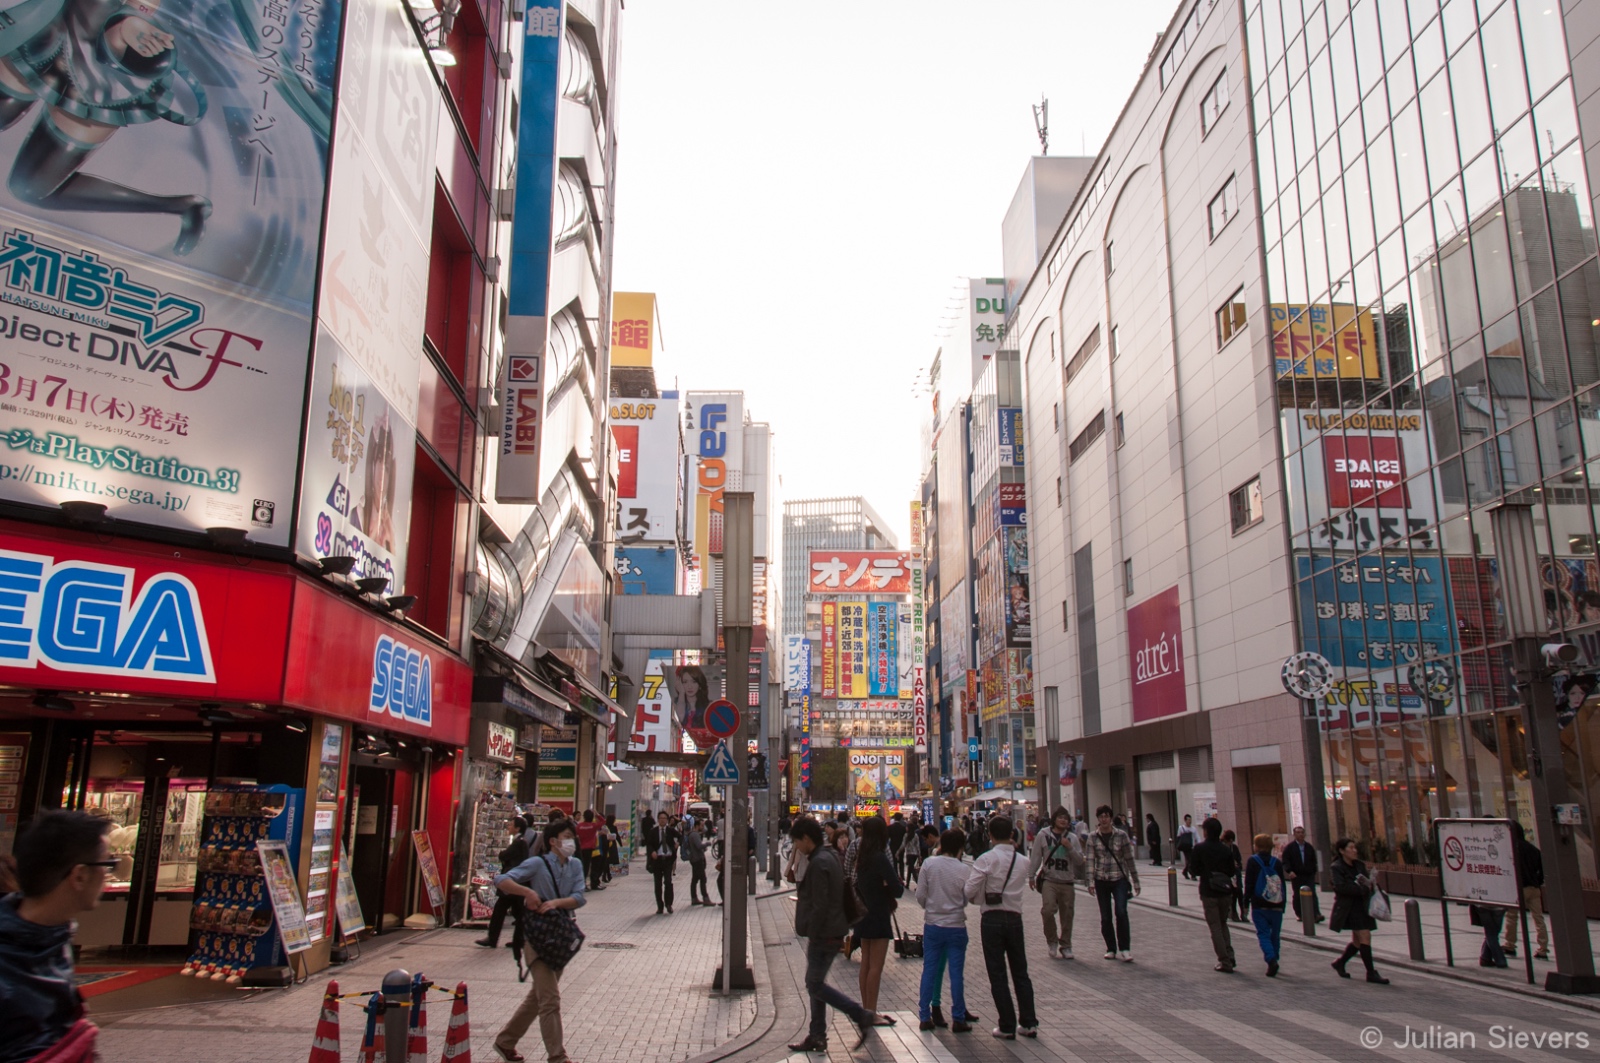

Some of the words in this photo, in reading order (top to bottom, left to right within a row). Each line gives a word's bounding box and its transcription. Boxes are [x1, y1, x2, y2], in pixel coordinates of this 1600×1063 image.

[527, 6, 559, 37] 館
[0, 231, 202, 348] 初音ミク
[3, 291, 70, 318] HATSUNE
[74, 311, 110, 328] MIKU
[38, 355, 82, 371] プロジェクト
[86, 366, 117, 380] ディーヴァ
[87, 331, 180, 380] DIVA
[162, 328, 264, 392] F
[504, 388, 514, 455] AKIHABARA
[514, 388, 538, 455] LABI
[254, 500, 274, 509] CERO
[913, 568, 923, 598] DUTY
[914, 603, 923, 632] FREE
[370, 634, 431, 727] SEGA
[1136, 632, 1171, 682] atré
[1172, 633, 1180, 673] 1
[914, 667, 925, 746] TAKARADA
